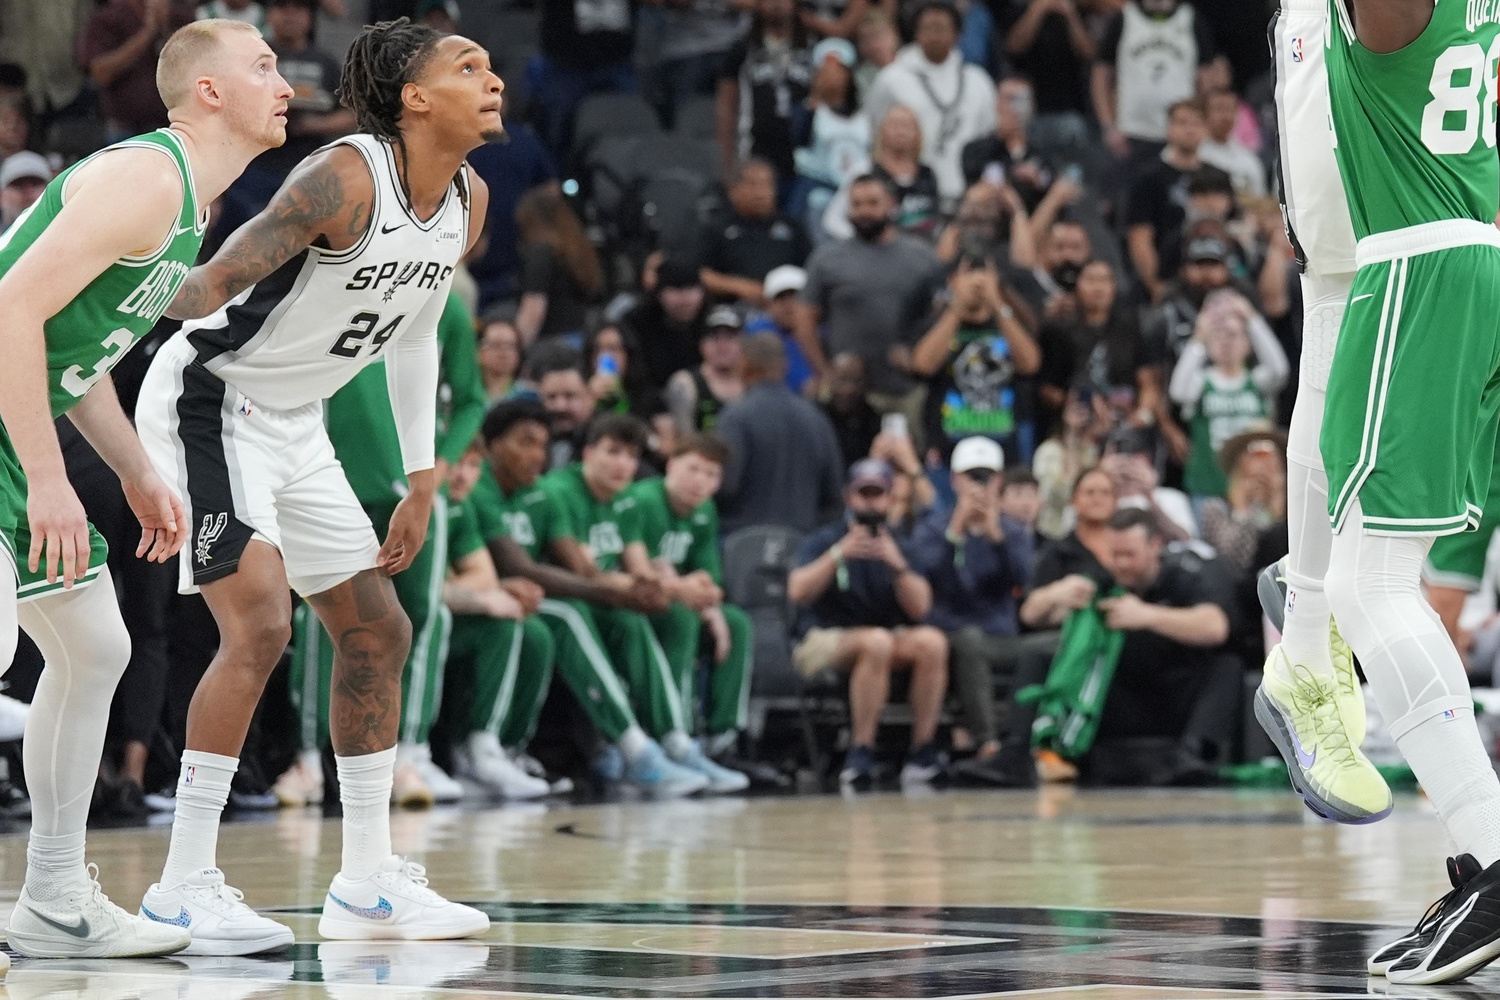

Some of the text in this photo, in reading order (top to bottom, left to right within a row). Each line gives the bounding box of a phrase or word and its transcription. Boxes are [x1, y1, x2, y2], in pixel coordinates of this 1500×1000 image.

[440, 231, 459, 240] LEDGER
[327, 310, 408, 359] 24
[61, 327, 141, 398] 3
